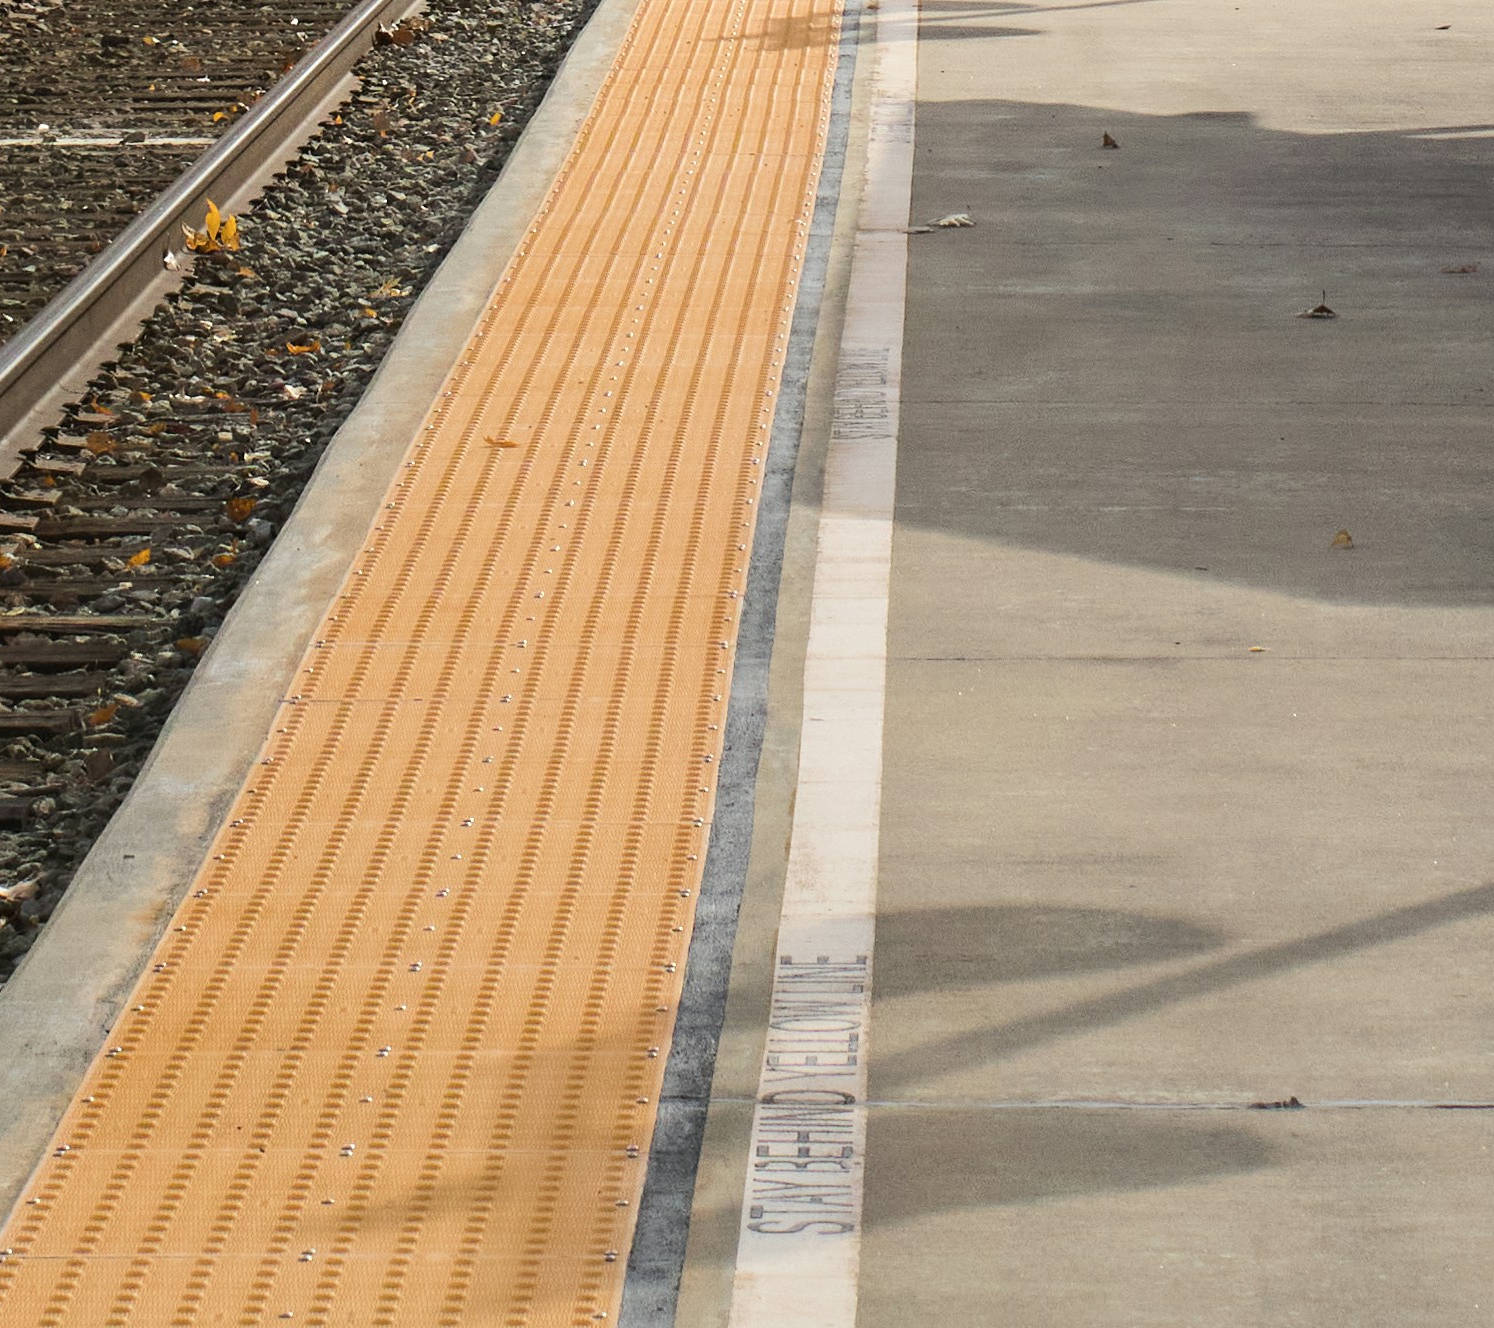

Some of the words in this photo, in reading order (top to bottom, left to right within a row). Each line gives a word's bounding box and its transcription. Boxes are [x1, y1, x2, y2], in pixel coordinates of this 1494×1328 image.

[763, 999, 861, 1083] YELLOW
[754, 1089, 857, 1173] BEHIND
[747, 1177, 855, 1235] STAY
